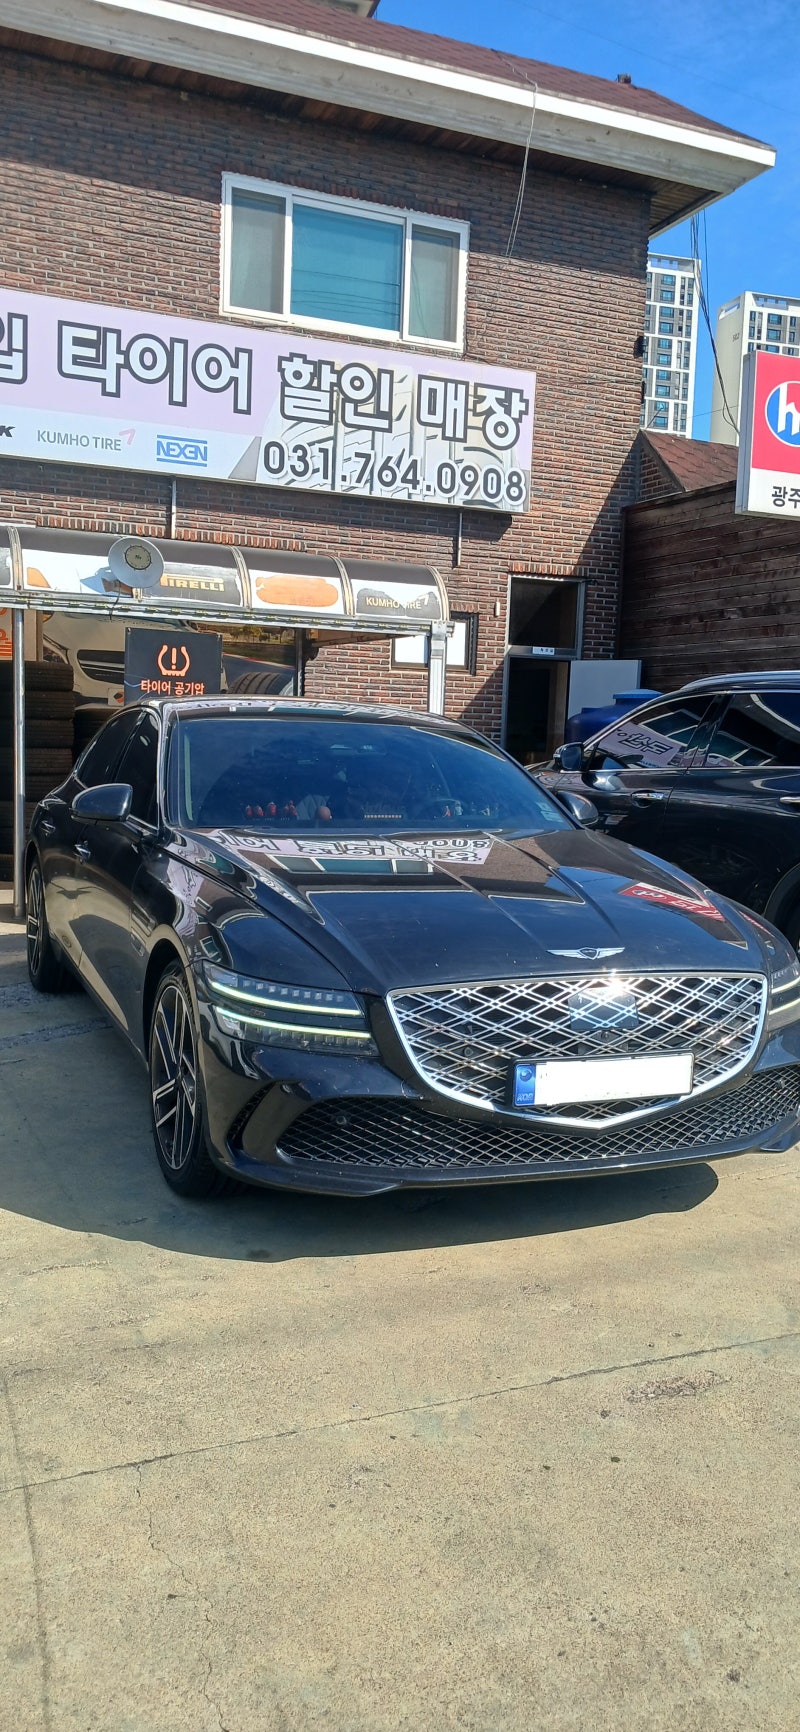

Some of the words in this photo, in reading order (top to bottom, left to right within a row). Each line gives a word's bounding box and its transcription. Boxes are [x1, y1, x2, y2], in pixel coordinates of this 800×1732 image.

[58, 320, 252, 415] 타이어
[278, 352, 393, 433] 할인
[417, 374, 529, 450] 매장
[37, 430, 90, 447] KUMHO
[92, 436, 121, 451] TIRE
[157, 440, 207, 461] NEXEN
[264, 441, 524, 501] 031.764.0908
[160, 573, 224, 591] PIRELLI
[366, 596, 399, 608] KUMHO
[406, 601, 422, 609] IRE
[141, 679, 171, 695] 타이어
[174, 682, 205, 697] 공기압
